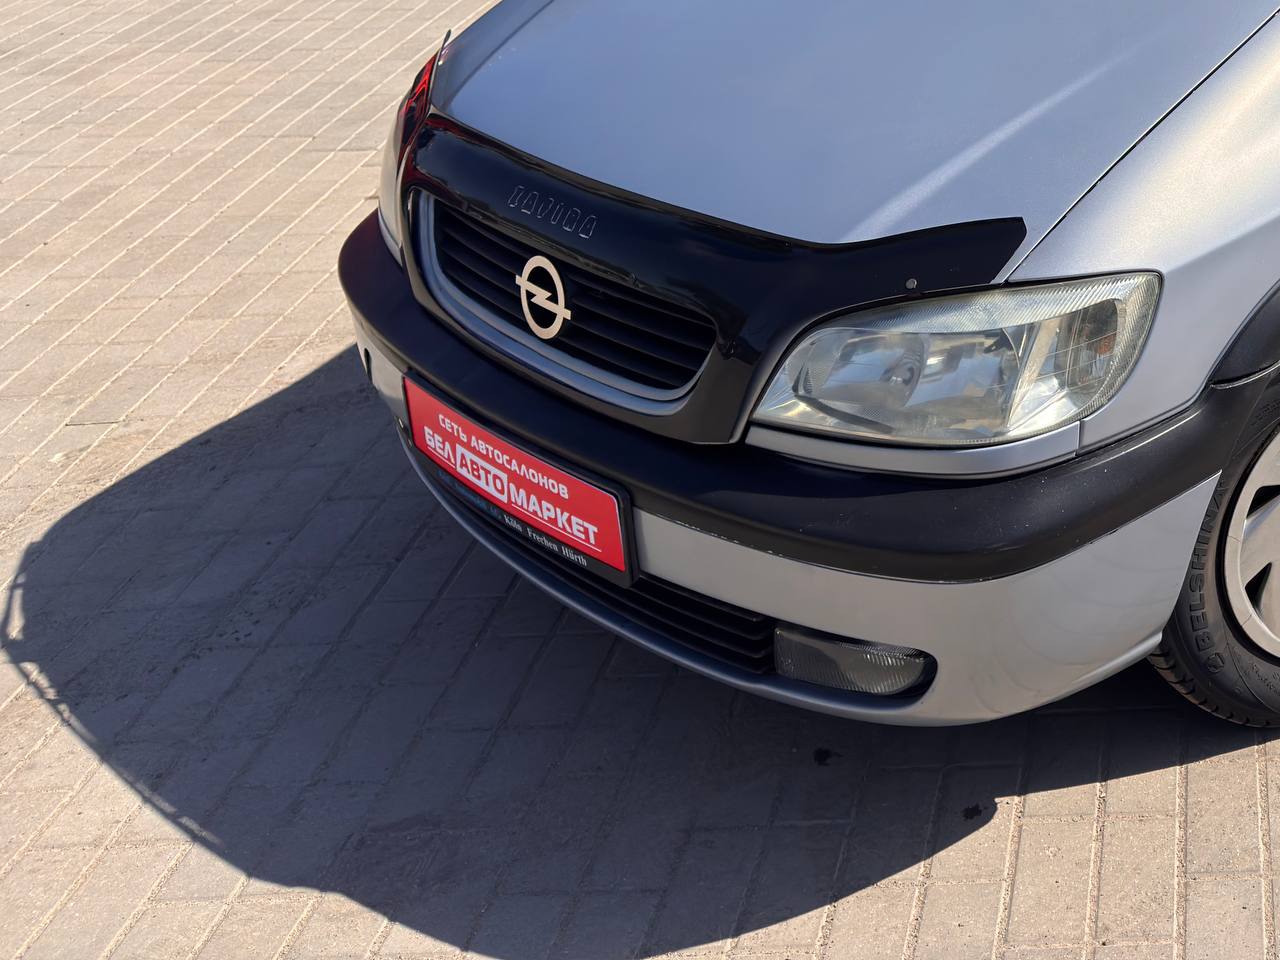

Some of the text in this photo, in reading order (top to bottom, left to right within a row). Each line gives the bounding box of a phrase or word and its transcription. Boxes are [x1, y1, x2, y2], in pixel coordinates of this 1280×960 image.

[424, 426, 455, 464] БЕЛ
[460, 454, 507, 496] АВТО
[509, 483, 598, 545] МАРКЕТ
[438, 414, 468, 442] СЕТЬ
[470, 436, 569, 499] АВТОСАЛОНОВ
